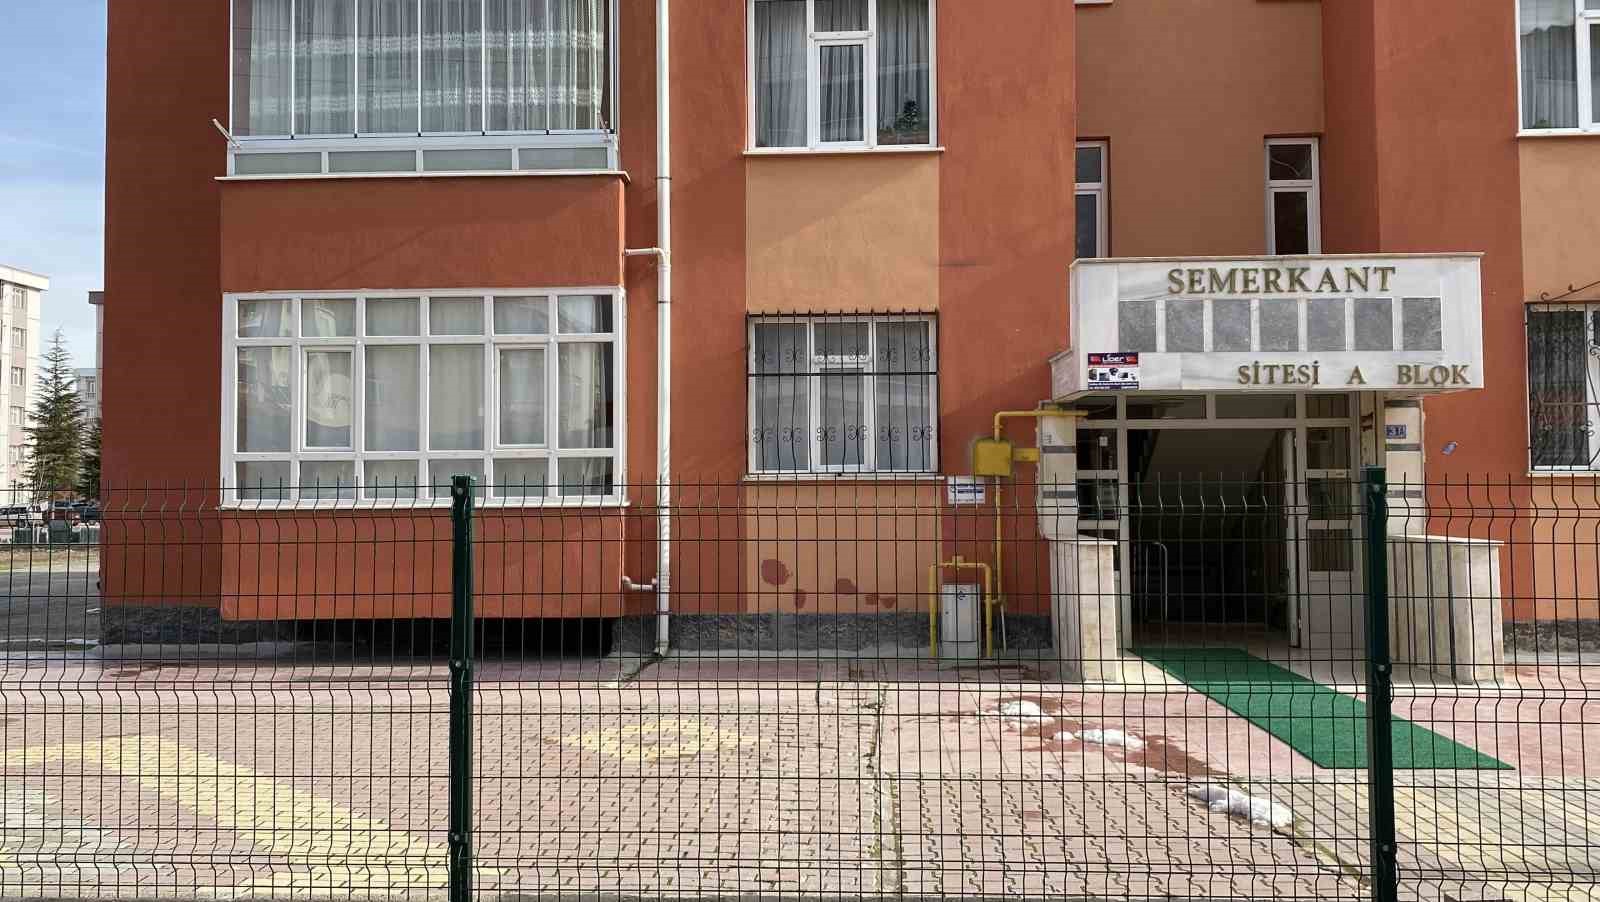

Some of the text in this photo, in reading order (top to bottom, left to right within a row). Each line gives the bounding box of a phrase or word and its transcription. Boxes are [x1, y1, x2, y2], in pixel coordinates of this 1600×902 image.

[1168, 267, 1396, 294] SEMERKANT
[1237, 360, 1470, 386] SİTESİ A BLOK
